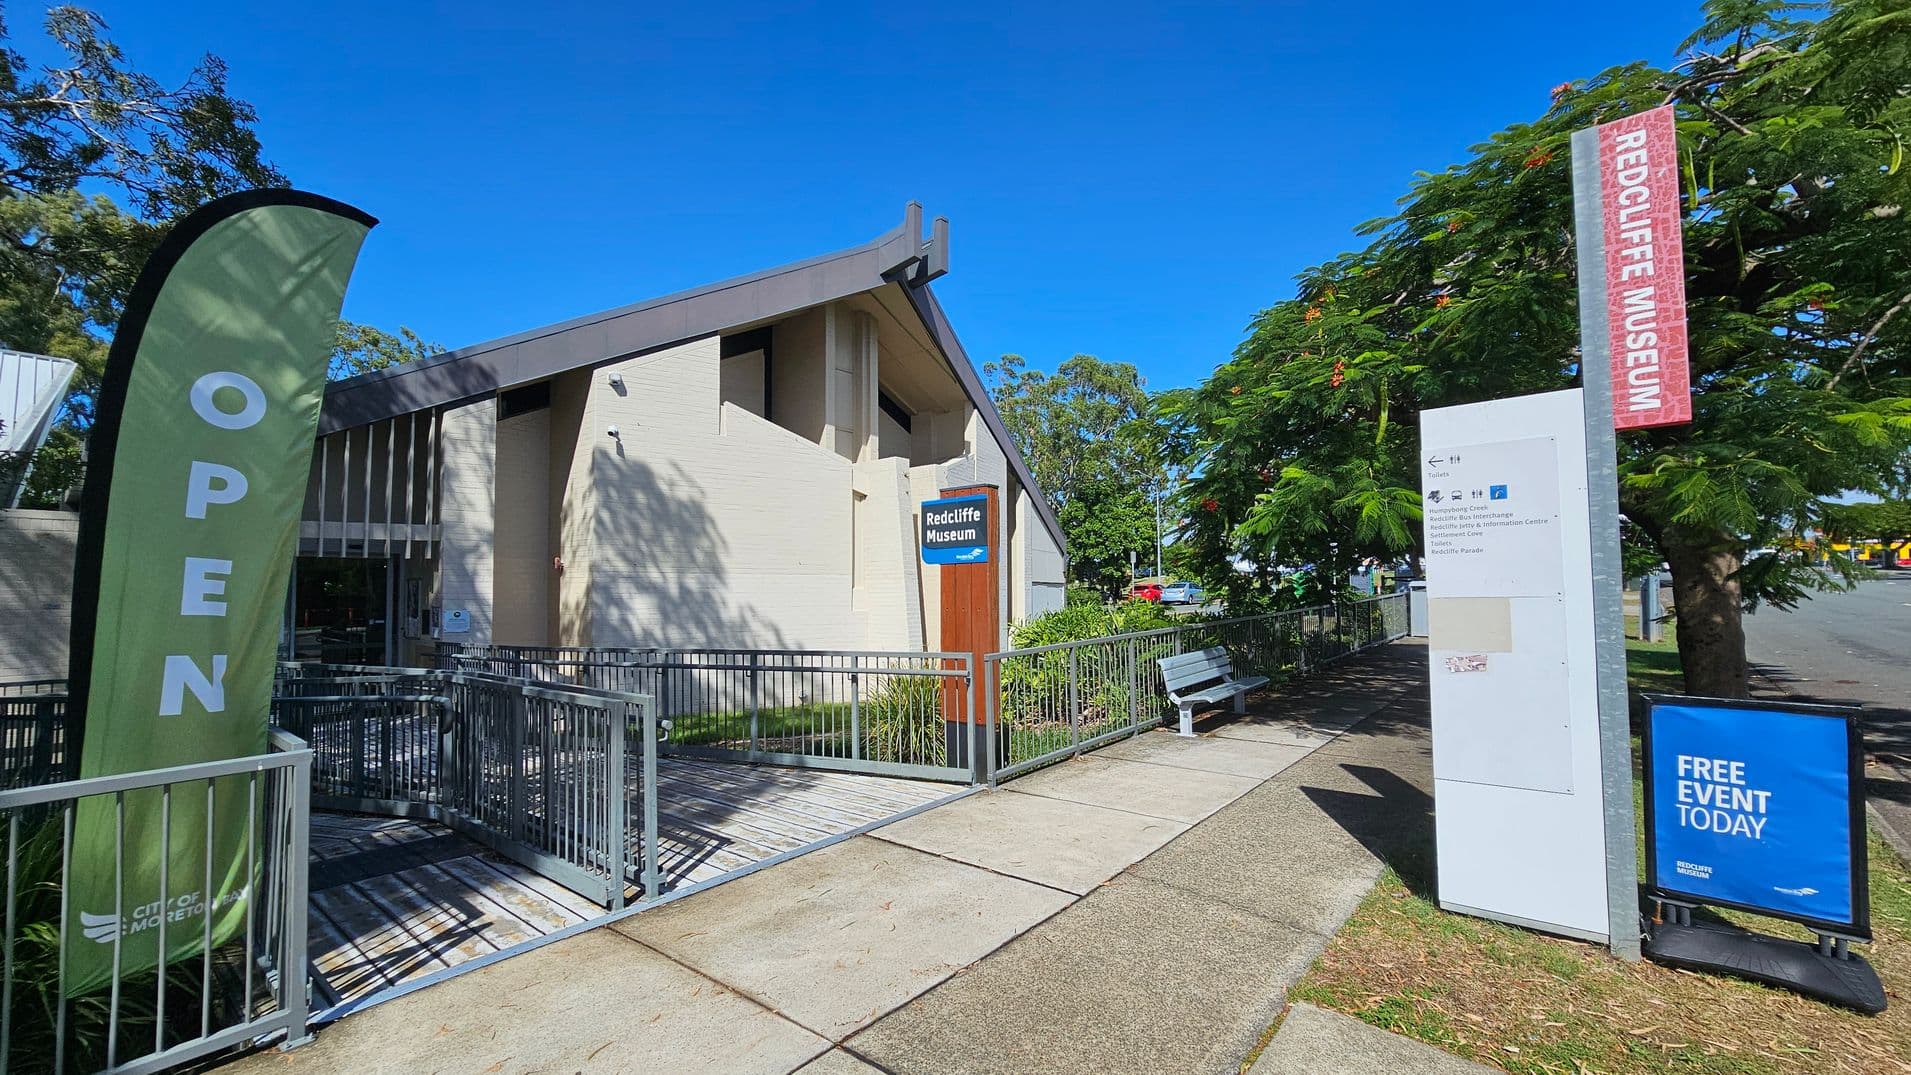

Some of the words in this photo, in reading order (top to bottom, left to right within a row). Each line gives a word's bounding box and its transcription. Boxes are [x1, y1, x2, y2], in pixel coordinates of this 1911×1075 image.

[1615, 129, 1655, 281] REDCLIFFE
[1623, 287, 1661, 411] MUSEUM
[926, 506, 981, 526] Redcliffe
[1483, 520, 1524, 528] Information
[159, 371, 267, 716] OPEN
[926, 528, 976, 543] Museum
[1677, 755, 1747, 785] FREE
[1677, 779, 1772, 814] EVENT
[1675, 804, 1768, 839] TODAY
[1676, 860, 1713, 874] REDCLIFFE
[1676, 867, 1710, 879] MUSEUM
[177, 891, 200, 907] OF
